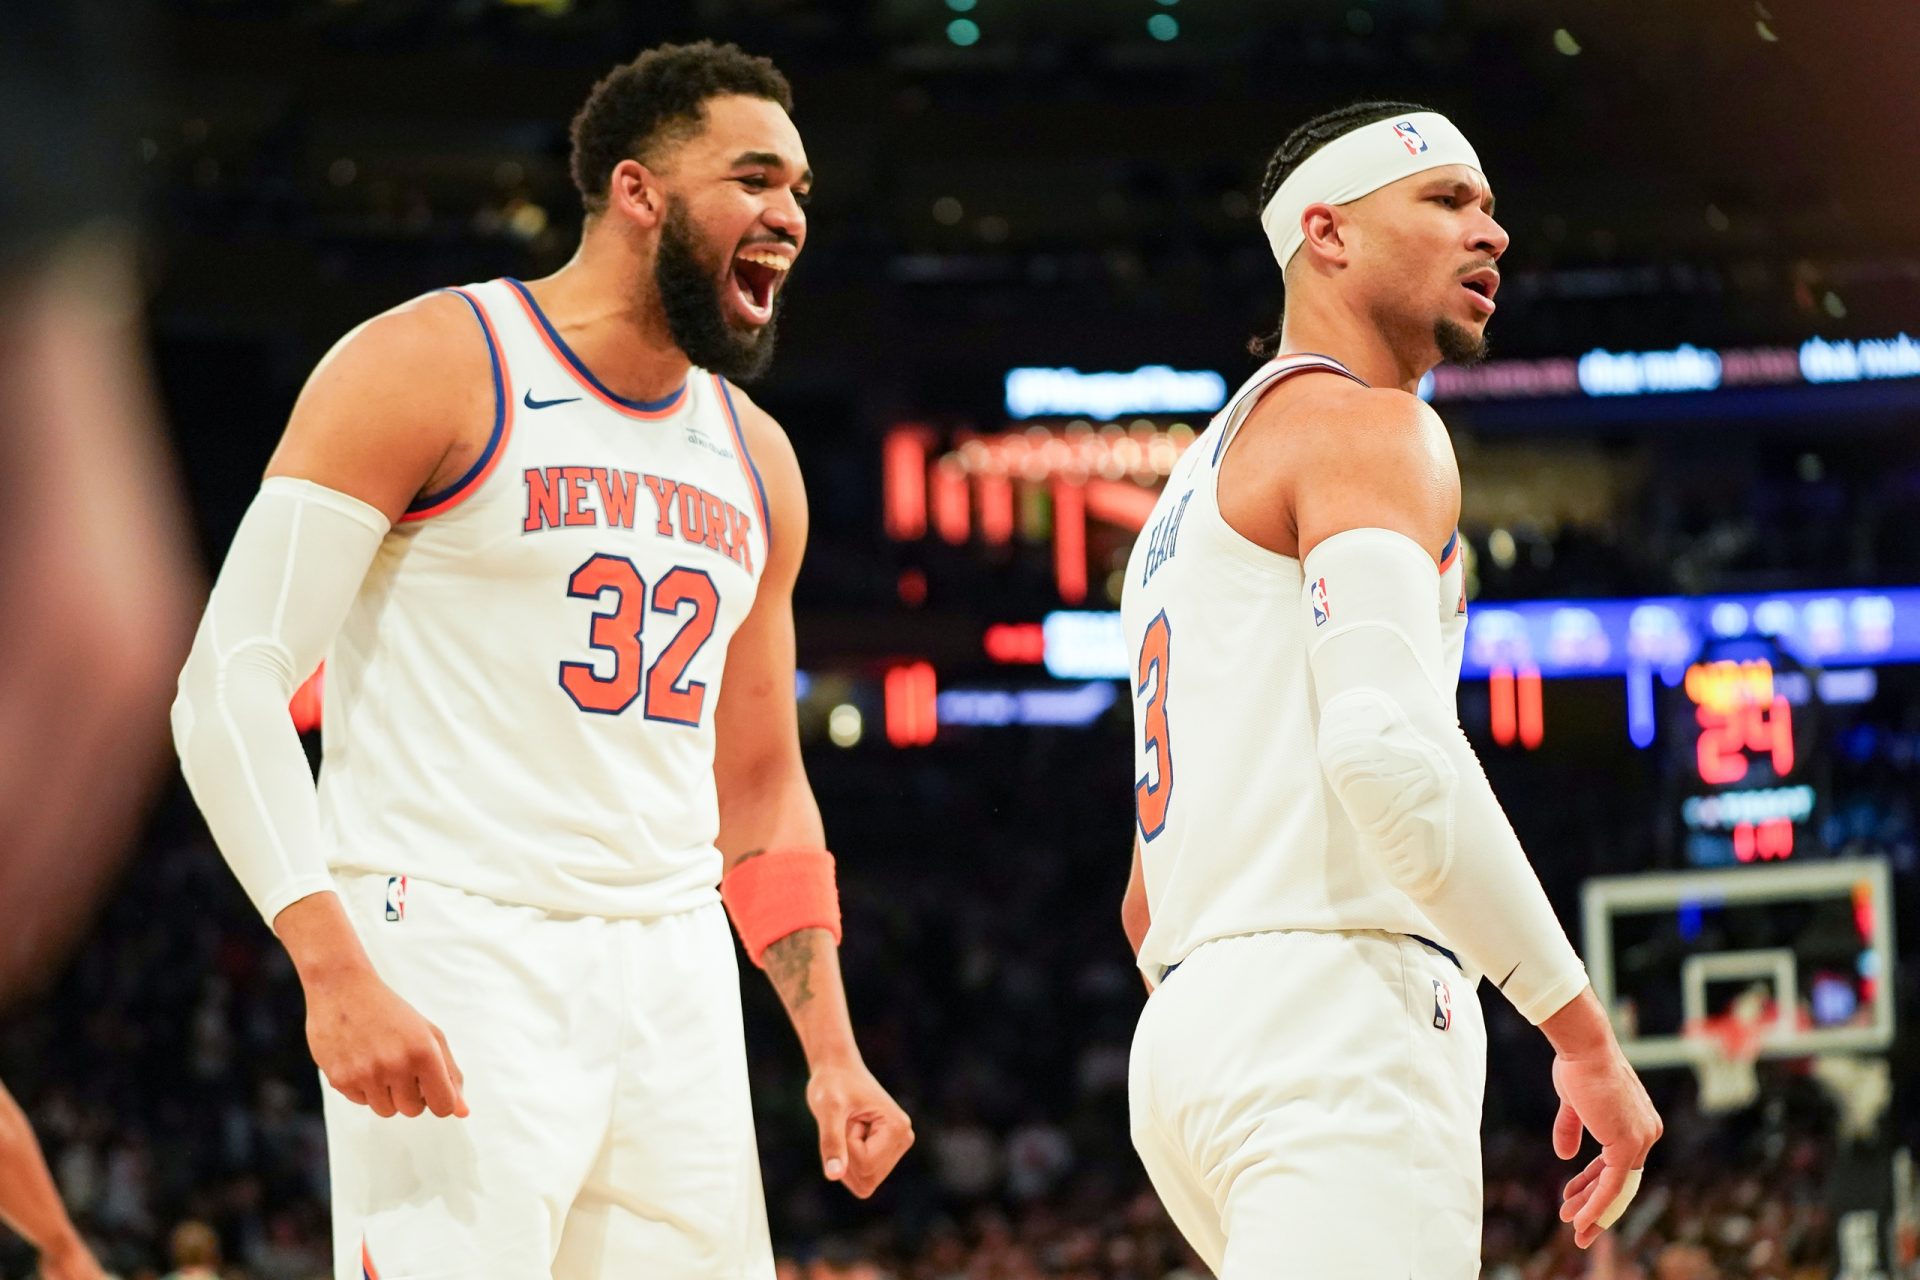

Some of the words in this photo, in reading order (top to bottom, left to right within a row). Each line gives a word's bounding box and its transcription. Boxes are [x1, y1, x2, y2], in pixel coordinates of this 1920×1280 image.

[522, 466, 639, 535] NEW
[643, 474, 754, 576] YORK
[559, 552, 720, 728] 32
[1135, 607, 1173, 843] 3
[1695, 694, 1795, 785] 24
